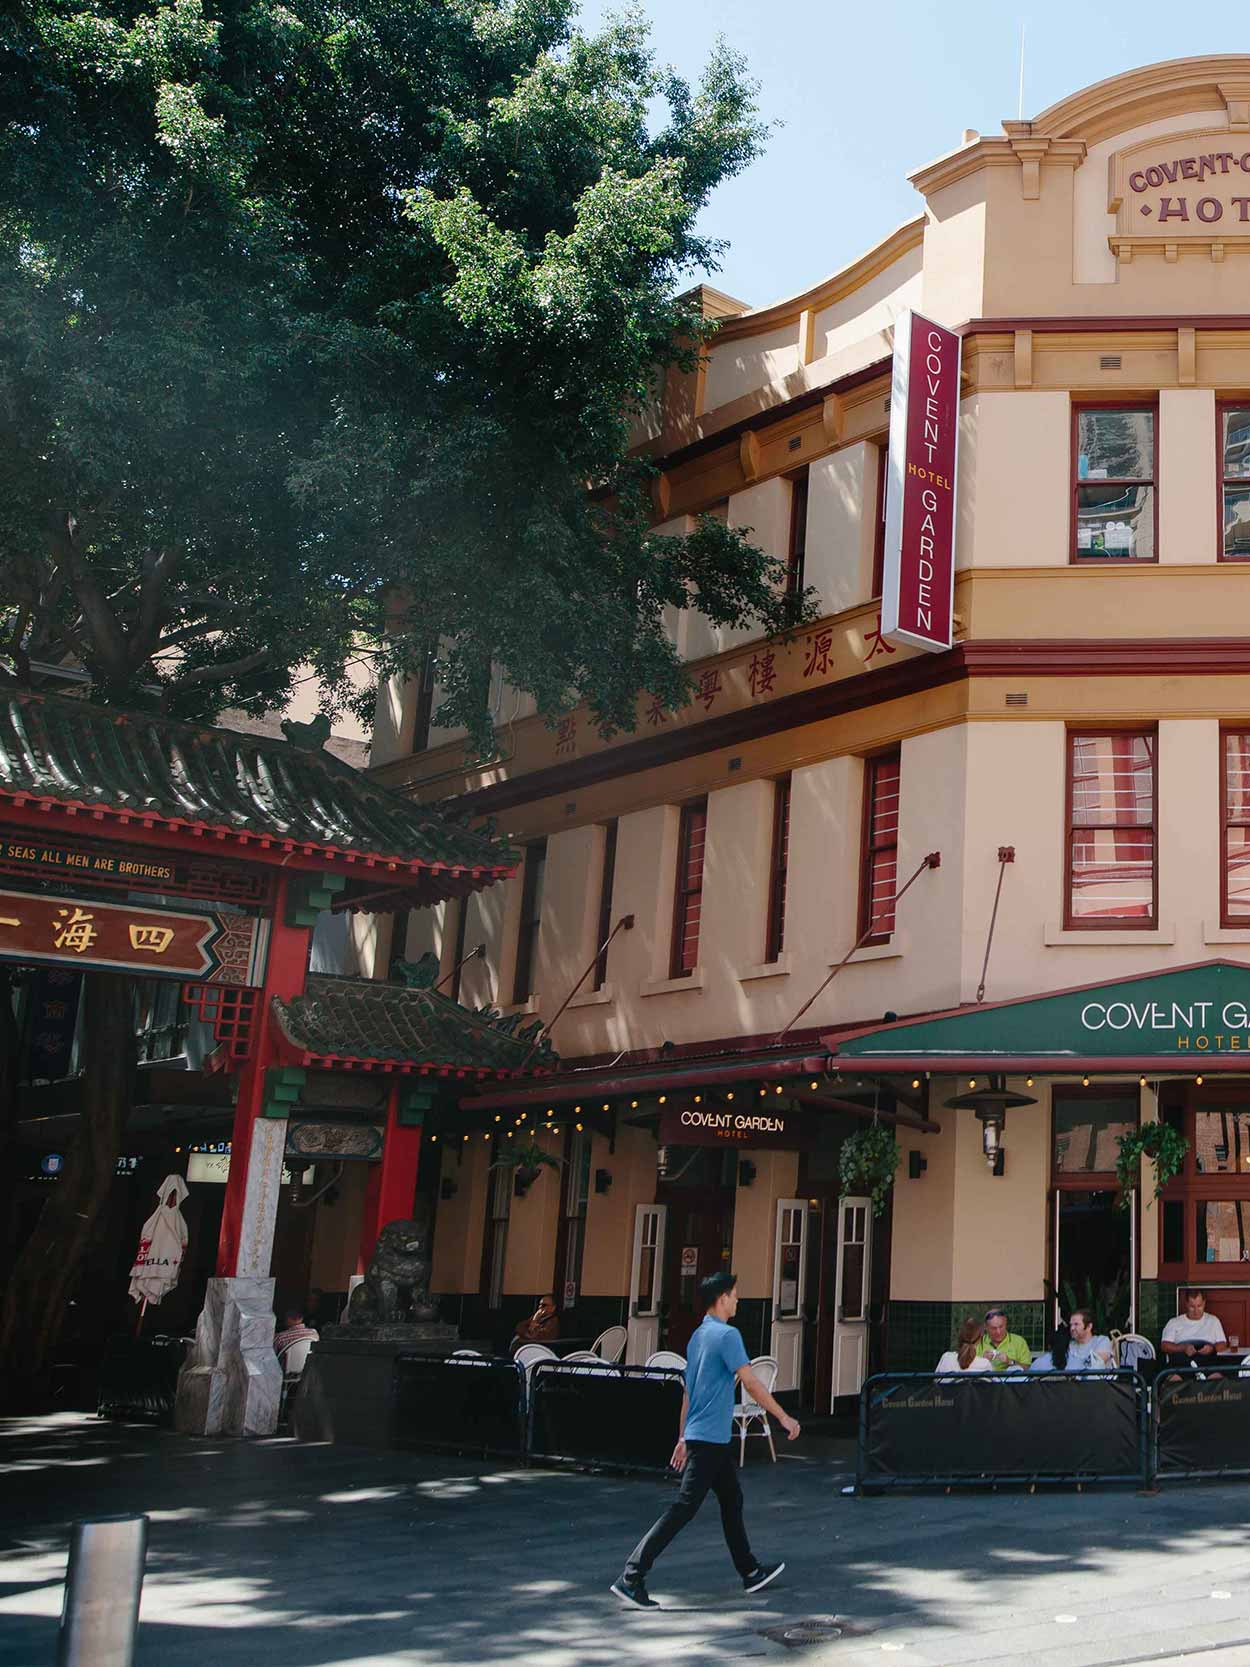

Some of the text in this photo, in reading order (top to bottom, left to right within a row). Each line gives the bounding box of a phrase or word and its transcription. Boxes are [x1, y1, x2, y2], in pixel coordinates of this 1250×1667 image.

[923, 331, 943, 464] COVENT
[908, 462, 952, 490] HOTEL
[916, 489, 938, 631] GARDEN
[7, 846, 36, 861] SEAS
[41, 851, 62, 864] ALL
[66, 854, 90, 869] MEN
[94, 858, 115, 872] ARE
[119, 860, 171, 879] BROTHERS
[1081, 1001, 1213, 1030] COVENT
[680, 1111, 784, 1132] COVENT GARDEN
[716, 1130, 748, 1139] HOTEL
